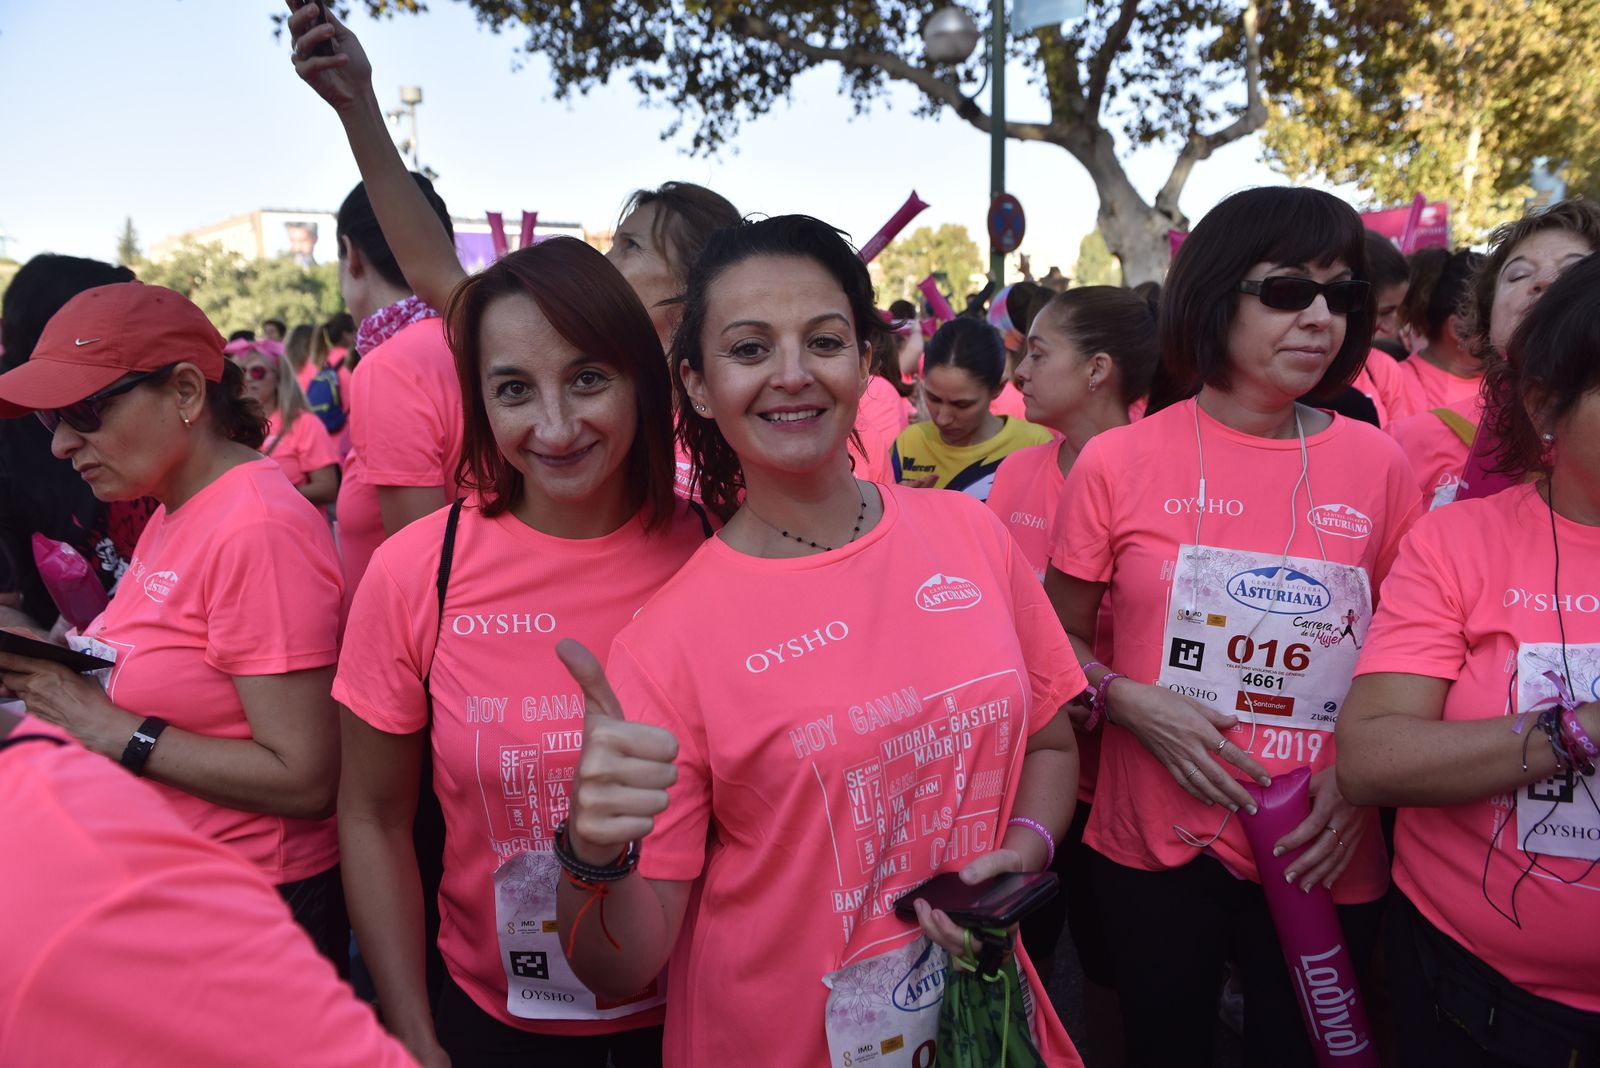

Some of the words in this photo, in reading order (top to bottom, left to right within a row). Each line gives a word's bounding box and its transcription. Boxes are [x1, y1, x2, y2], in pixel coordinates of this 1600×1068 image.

[1163, 497, 1244, 516] OYSHO
[1010, 511, 1048, 530] OYSHO
[1314, 511, 1369, 534] ASTURIANA
[923, 588, 980, 608] ASTURIANA
[1233, 578, 1323, 607] ASTURIANA
[1502, 588, 1600, 613] OYSHO
[452, 612, 557, 635] OYSHO
[1293, 616, 1333, 632] Carrera
[745, 620, 849, 673] OYSHO
[1313, 630, 1344, 648] Mujer
[1227, 634, 1312, 672] 016
[1242, 672, 1284, 690] 4661
[1169, 683, 1218, 702] OYSHO
[466, 696, 509, 723] HOY
[521, 694, 584, 722] GANA
[1252, 698, 1287, 711] Santander
[789, 713, 838, 760] HOY
[847, 686, 922, 735] GANAN
[1310, 712, 1338, 723] ZURIC
[883, 723, 937, 760] VITORIA
[950, 699, 1009, 733] GASTEIZ
[547, 731, 583, 750] VITO
[914, 731, 972, 769] MADRID
[1261, 728, 1322, 763] 2019
[501, 750, 520, 767] SE
[502, 767, 516, 783] VI
[847, 769, 866, 789] SE
[504, 782, 521, 796] LL
[849, 787, 866, 807] VI
[854, 805, 872, 825] LL
[921, 806, 954, 837] LAS
[1532, 822, 1600, 841] OYSHO
[521, 988, 575, 1004] OYSHO
[858, 1044, 873, 1054] IMD
